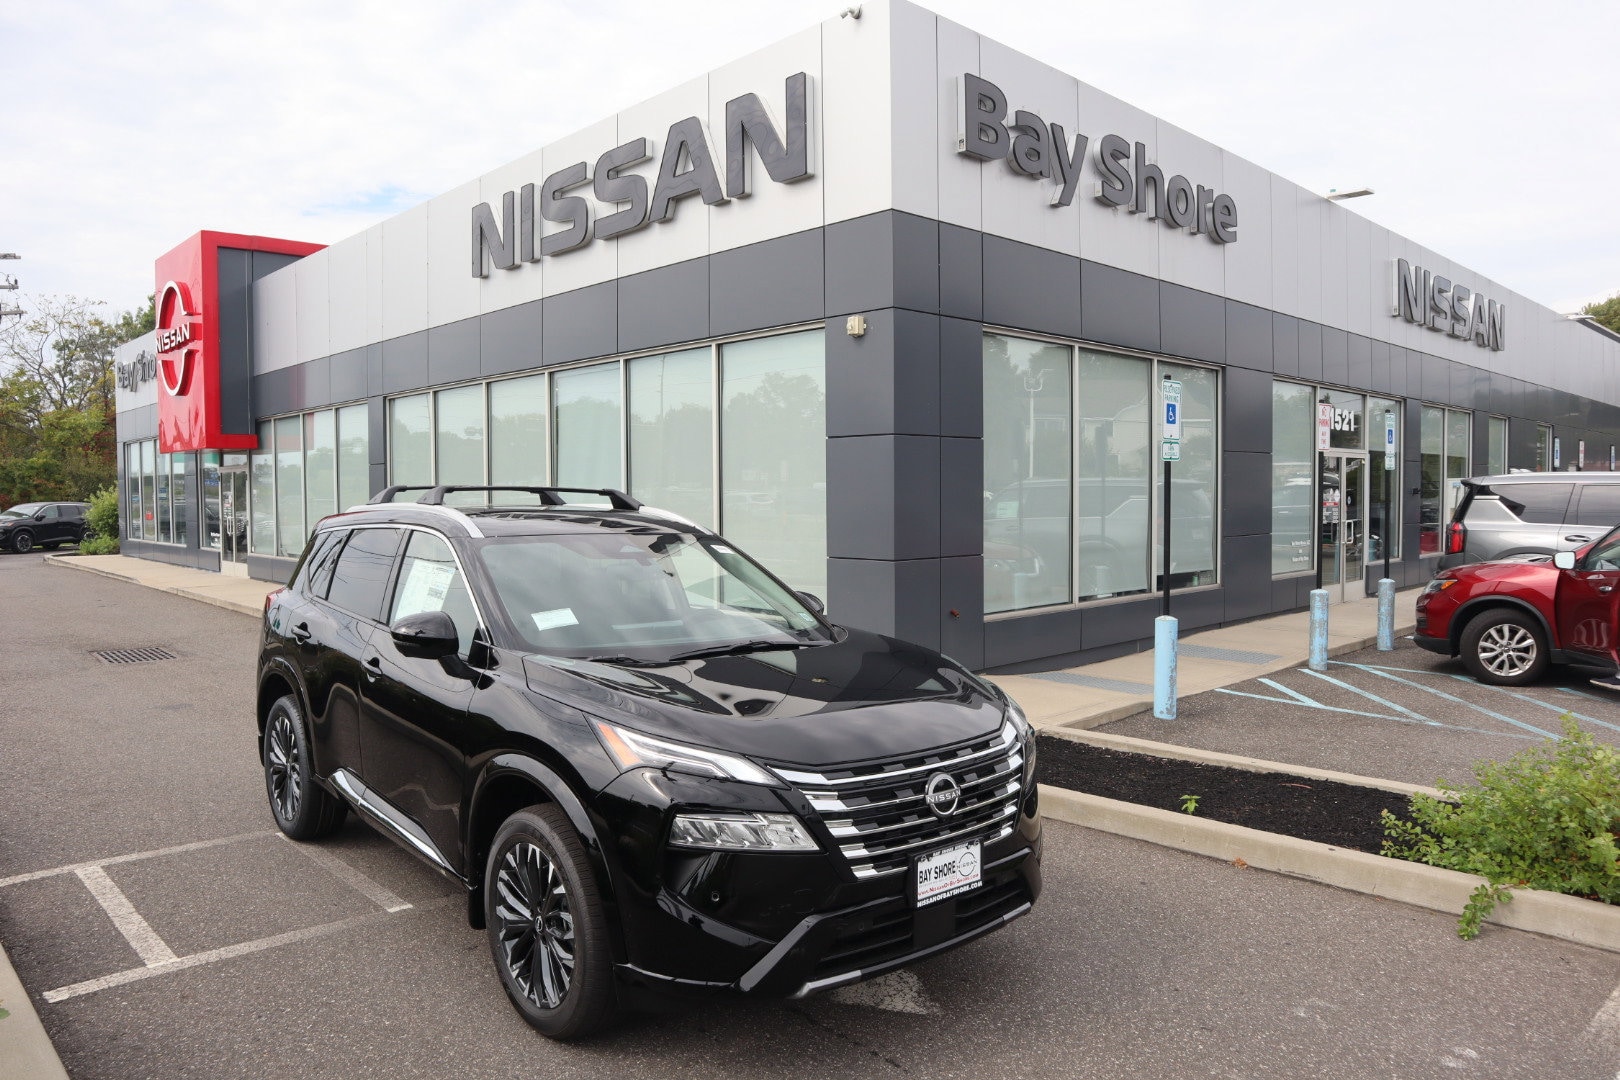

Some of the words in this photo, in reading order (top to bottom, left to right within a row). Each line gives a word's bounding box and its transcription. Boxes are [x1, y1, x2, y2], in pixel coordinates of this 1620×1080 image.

[957, 73, 1088, 207] Bay
[1094, 134, 1238, 244] Shore
[472, 72, 814, 278] NISSAN
[1392, 258, 1505, 351] NISSAN
[156, 323, 190, 353] NISSAN
[117, 360, 137, 392] Bay
[136, 350, 157, 383] Sho
[1330, 407, 1354, 432] 1521
[927, 788, 961, 803] NISSAN
[919, 867, 933, 884] BAY
[934, 860, 956, 879] SHORE
[917, 881, 983, 908] NISSANOFBAYSHORE.COM
